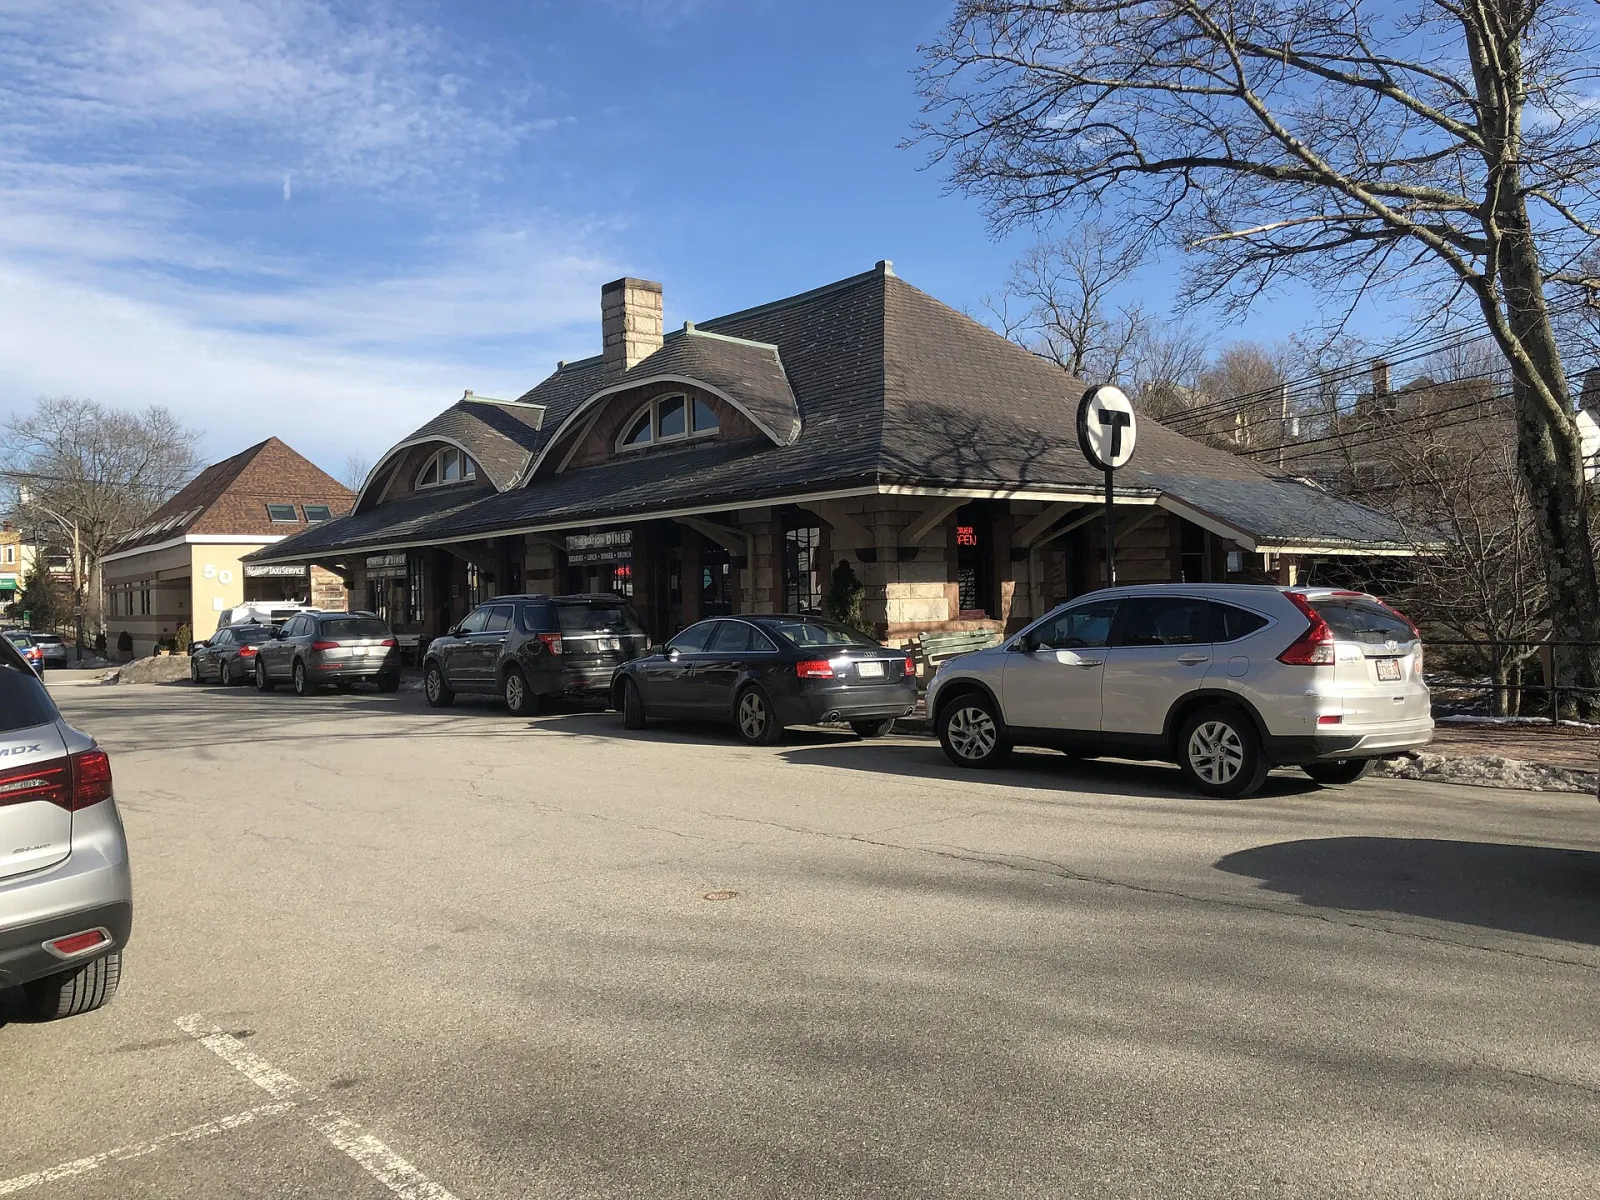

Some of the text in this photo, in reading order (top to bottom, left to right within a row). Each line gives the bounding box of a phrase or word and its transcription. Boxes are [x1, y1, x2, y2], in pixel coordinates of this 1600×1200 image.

[1098, 408, 1130, 457] T
[606, 532, 631, 545] DINER
[202, 563, 233, 585] 50
